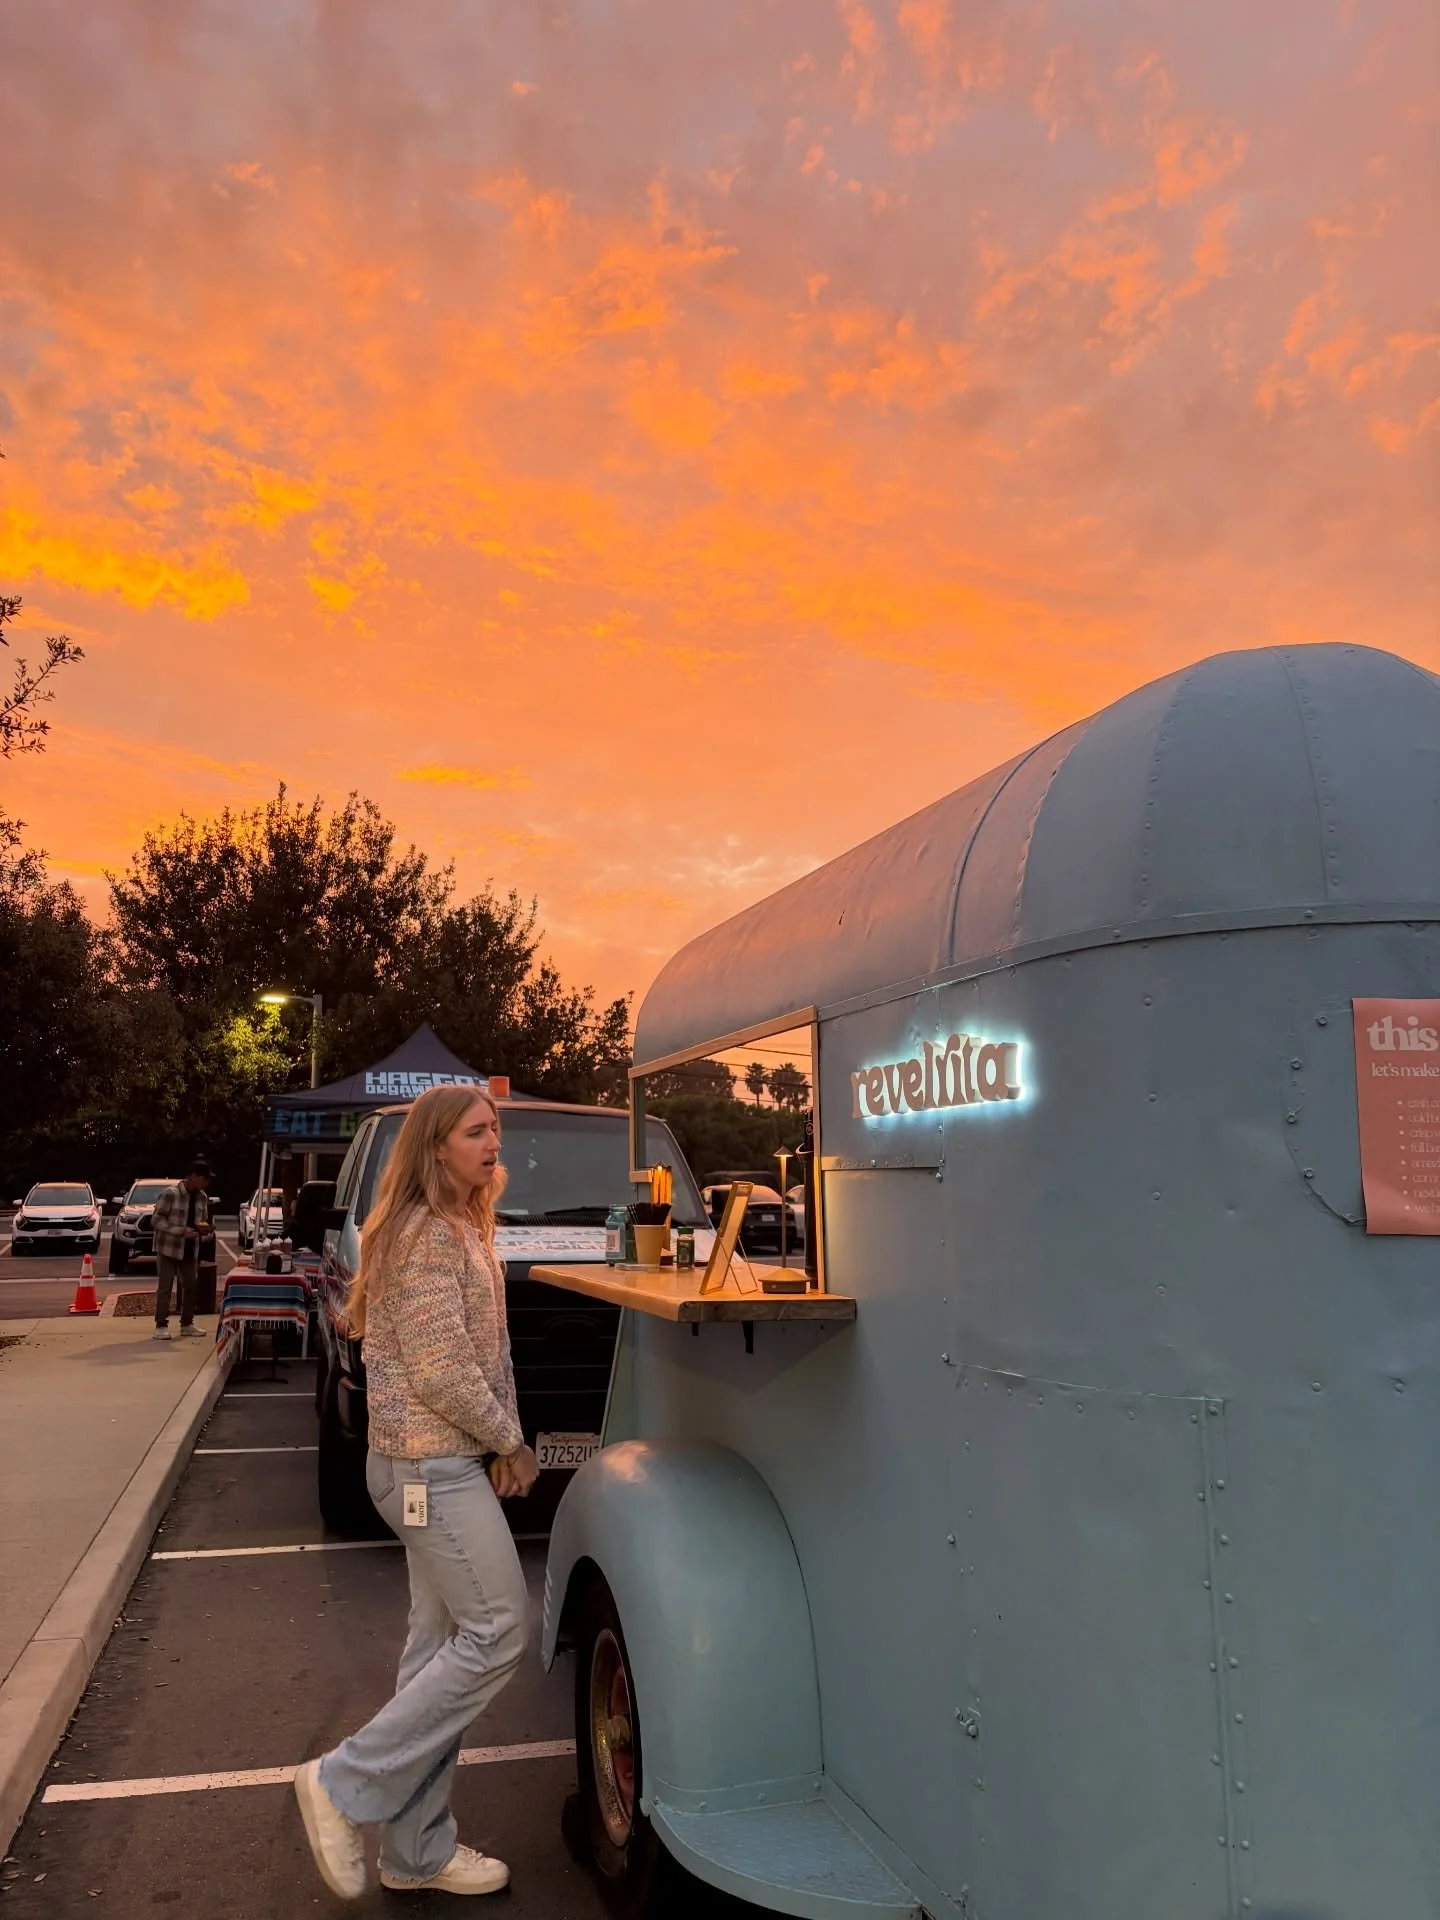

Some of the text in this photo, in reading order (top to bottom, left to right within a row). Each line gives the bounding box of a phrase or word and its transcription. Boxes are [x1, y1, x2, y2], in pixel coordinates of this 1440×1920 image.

[1367, 1016, 1439, 1051] this
[1371, 1062, 1440, 1077] let's make
[273, 1109, 327, 1136] EAT
[540, 1445, 600, 1464] 37252U
